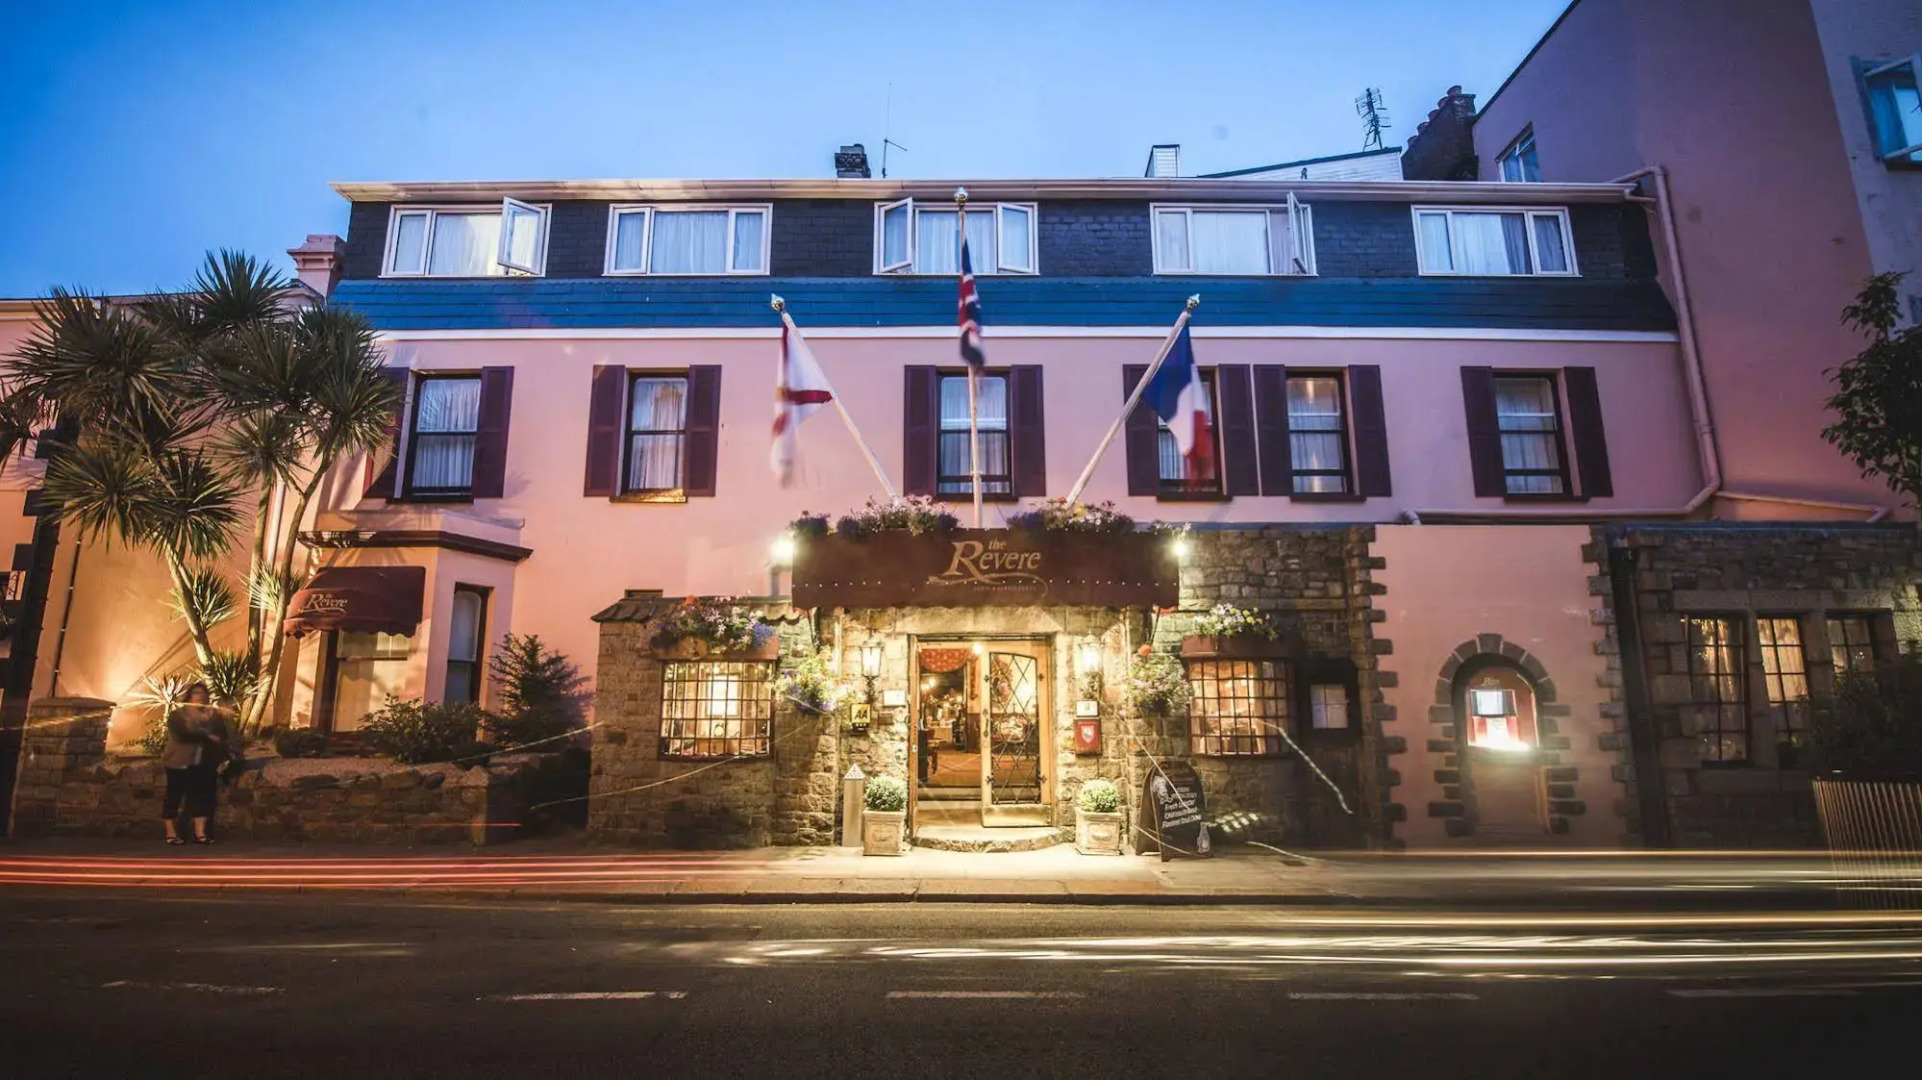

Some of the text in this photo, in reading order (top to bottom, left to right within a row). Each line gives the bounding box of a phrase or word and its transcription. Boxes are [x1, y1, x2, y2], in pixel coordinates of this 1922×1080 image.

[988, 538, 1007, 551] the
[941, 540, 1042, 580] Revere
[305, 593, 348, 610] Revere
[854, 709, 868, 720] AA
